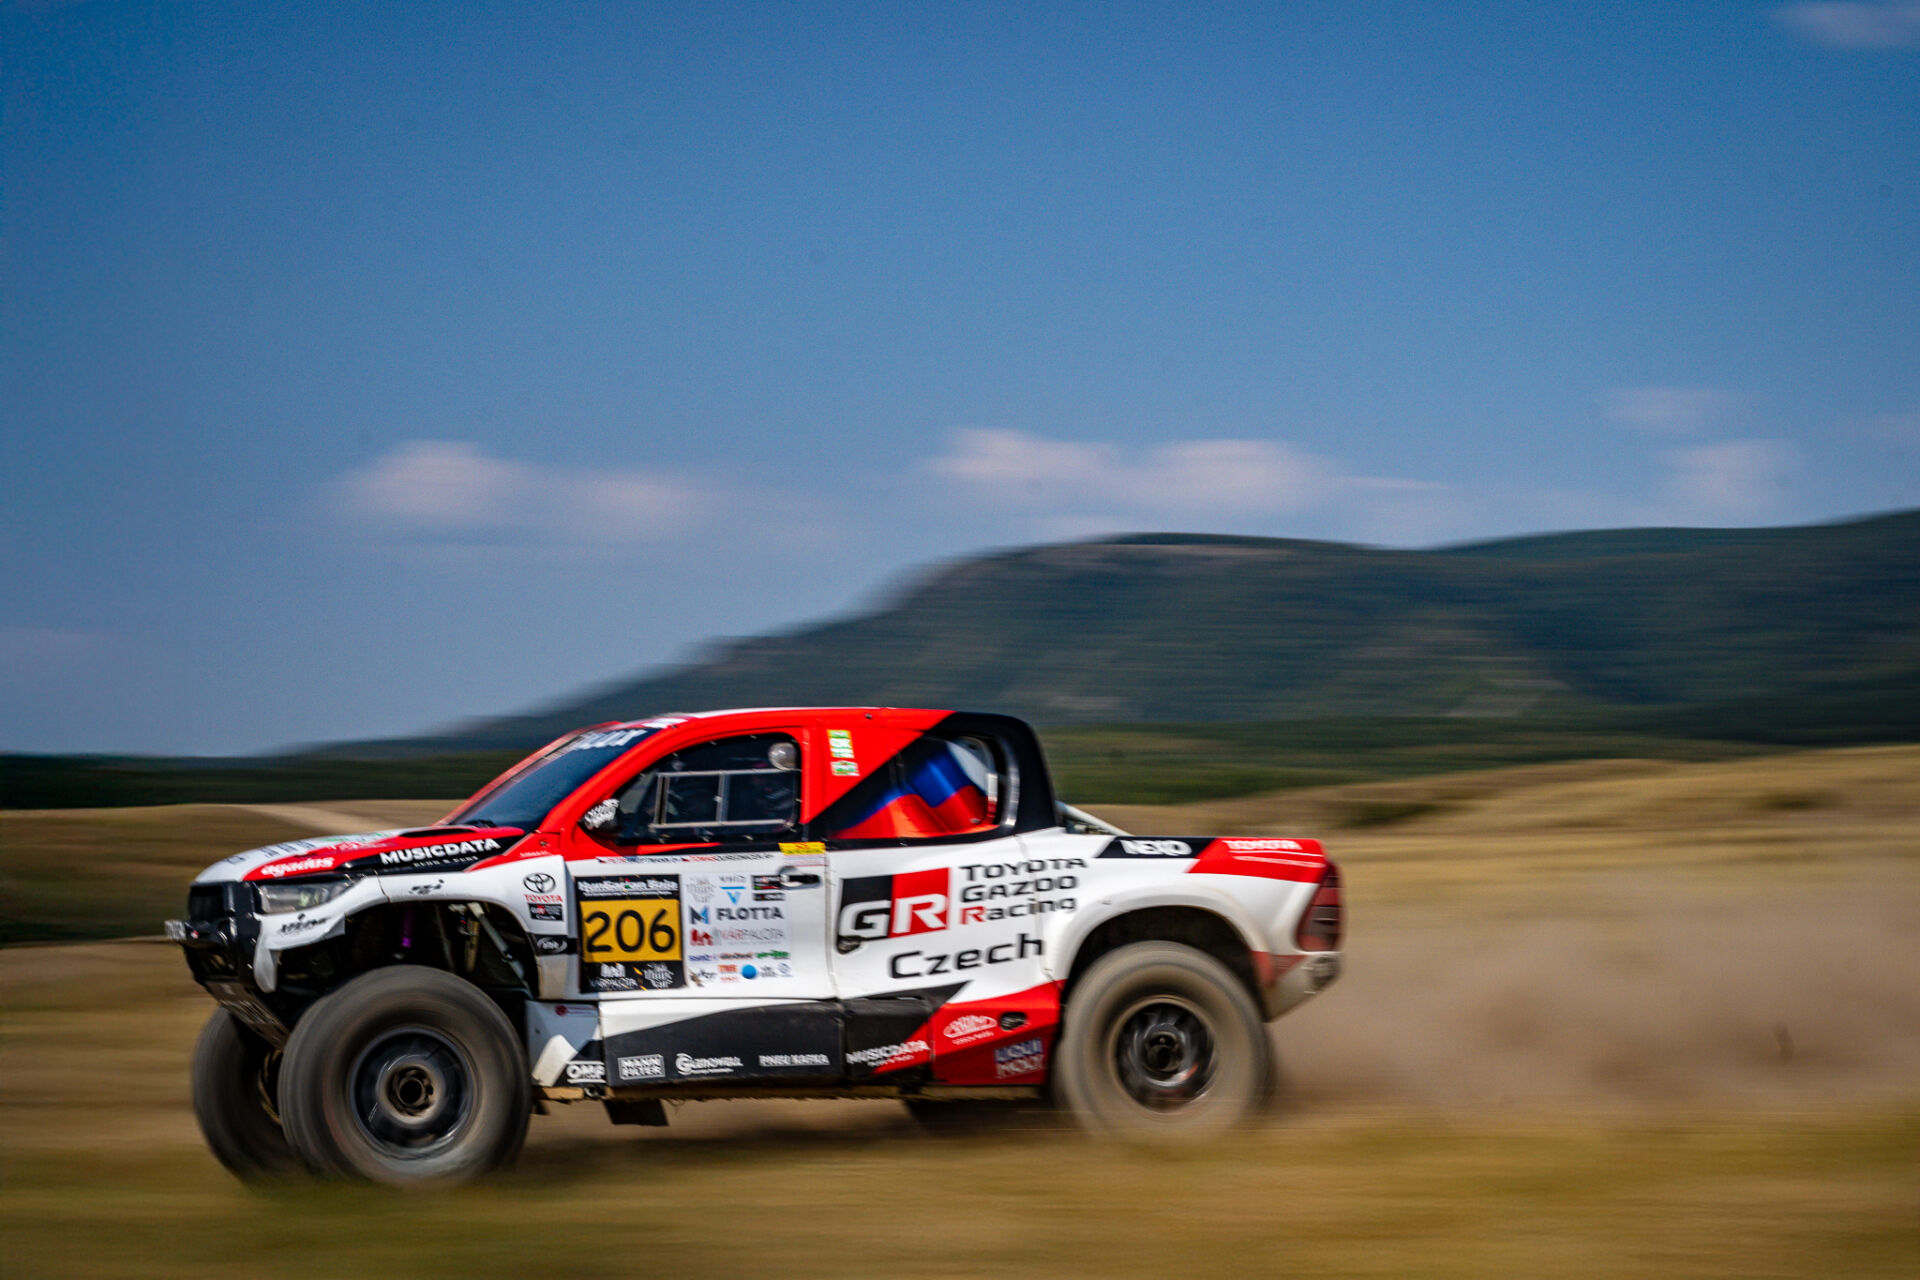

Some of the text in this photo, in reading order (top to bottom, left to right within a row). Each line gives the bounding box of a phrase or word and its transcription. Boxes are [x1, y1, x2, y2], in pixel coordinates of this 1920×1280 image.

[380, 838, 500, 865] MUSICDATA
[959, 858, 1088, 881] TOYOTA
[524, 894, 563, 902] TOYOTA
[960, 875, 1077, 902] GAZOO
[717, 906, 784, 920] FLOTTA
[838, 893, 949, 939] GR
[959, 897, 1077, 924] Racing
[584, 909, 675, 953] 206
[889, 932, 1045, 979] Czech
[620, 1057, 662, 1069] MANN
[846, 1040, 930, 1065] MUSICDATA
[566, 1064, 605, 1079] OMP
[621, 1065, 664, 1078] FILTER
